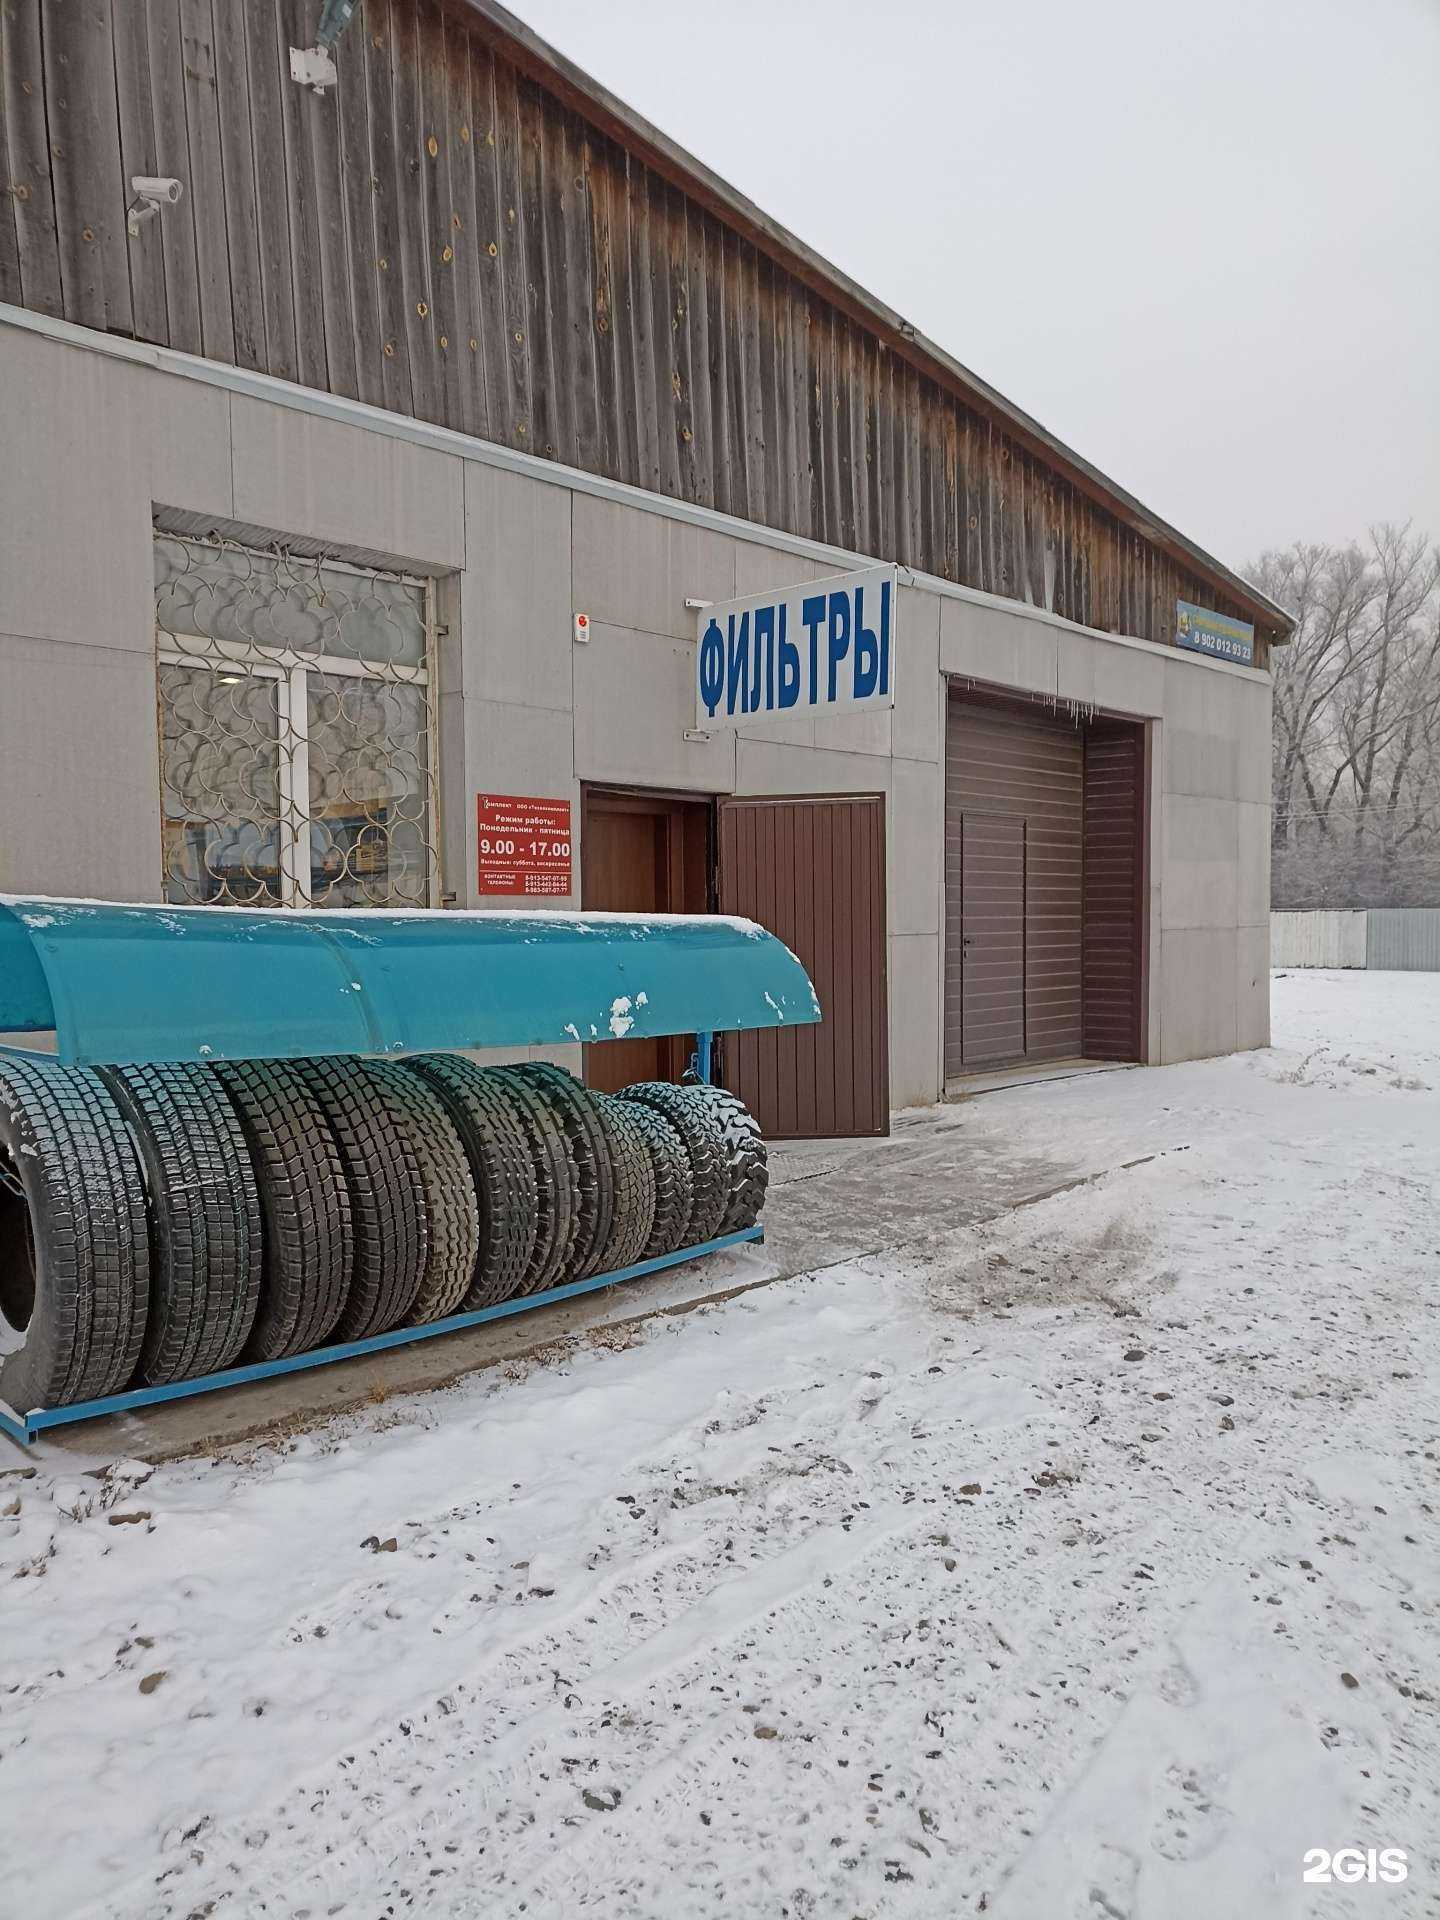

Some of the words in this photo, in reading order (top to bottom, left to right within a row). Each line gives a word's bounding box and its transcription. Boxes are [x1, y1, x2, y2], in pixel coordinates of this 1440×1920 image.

[699, 581, 891, 718] ФИЛЬТРЫ
[1194, 631, 1200, 644] 8
[1201, 633, 1215, 649] 902
[1216, 638, 1231, 653] 012
[1232, 642, 1241, 657] 93
[495, 814, 523, 823] Режим
[525, 816, 556, 826] работы:
[480, 823, 533, 833] Понедельник
[539, 828, 570, 836] пятница
[480, 839, 515, 855] 9.00
[529, 841, 570, 857] 17.00
